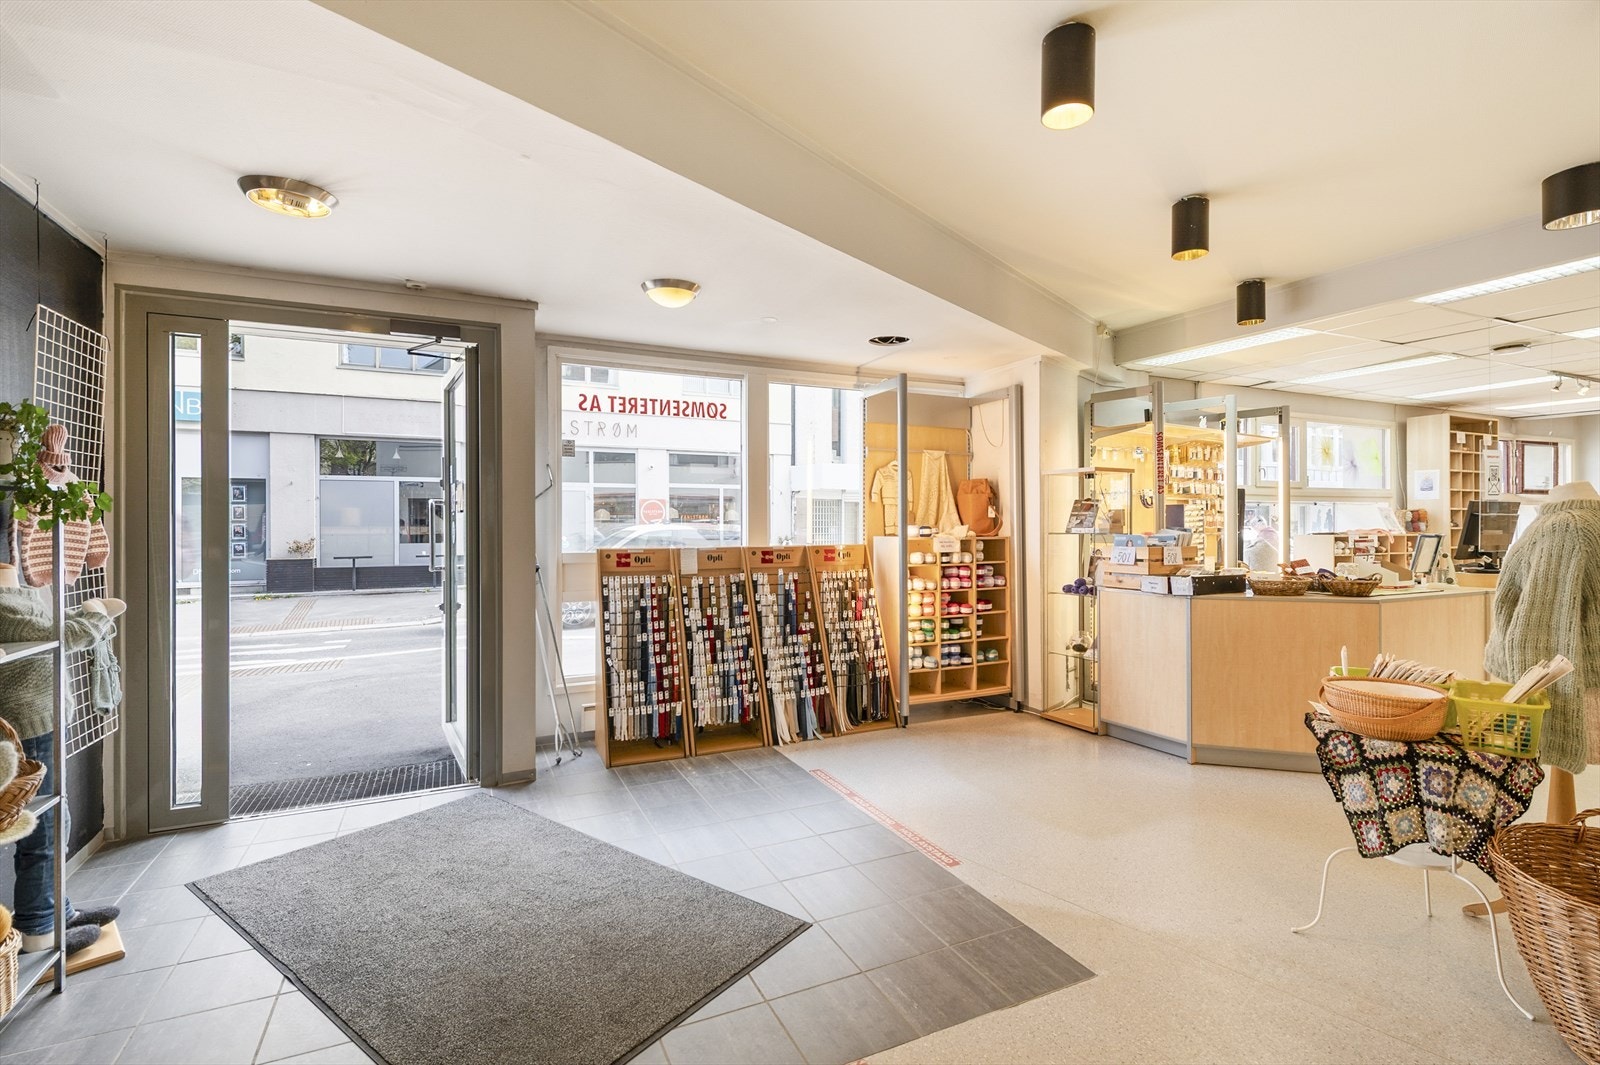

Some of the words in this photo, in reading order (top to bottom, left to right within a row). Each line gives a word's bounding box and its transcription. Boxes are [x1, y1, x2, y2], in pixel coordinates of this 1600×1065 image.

[562, 420, 638, 438] STRØM
[634, 555, 651, 564] Opti
[706, 553, 723, 563] Opti
[776, 551, 791, 561] Opti
